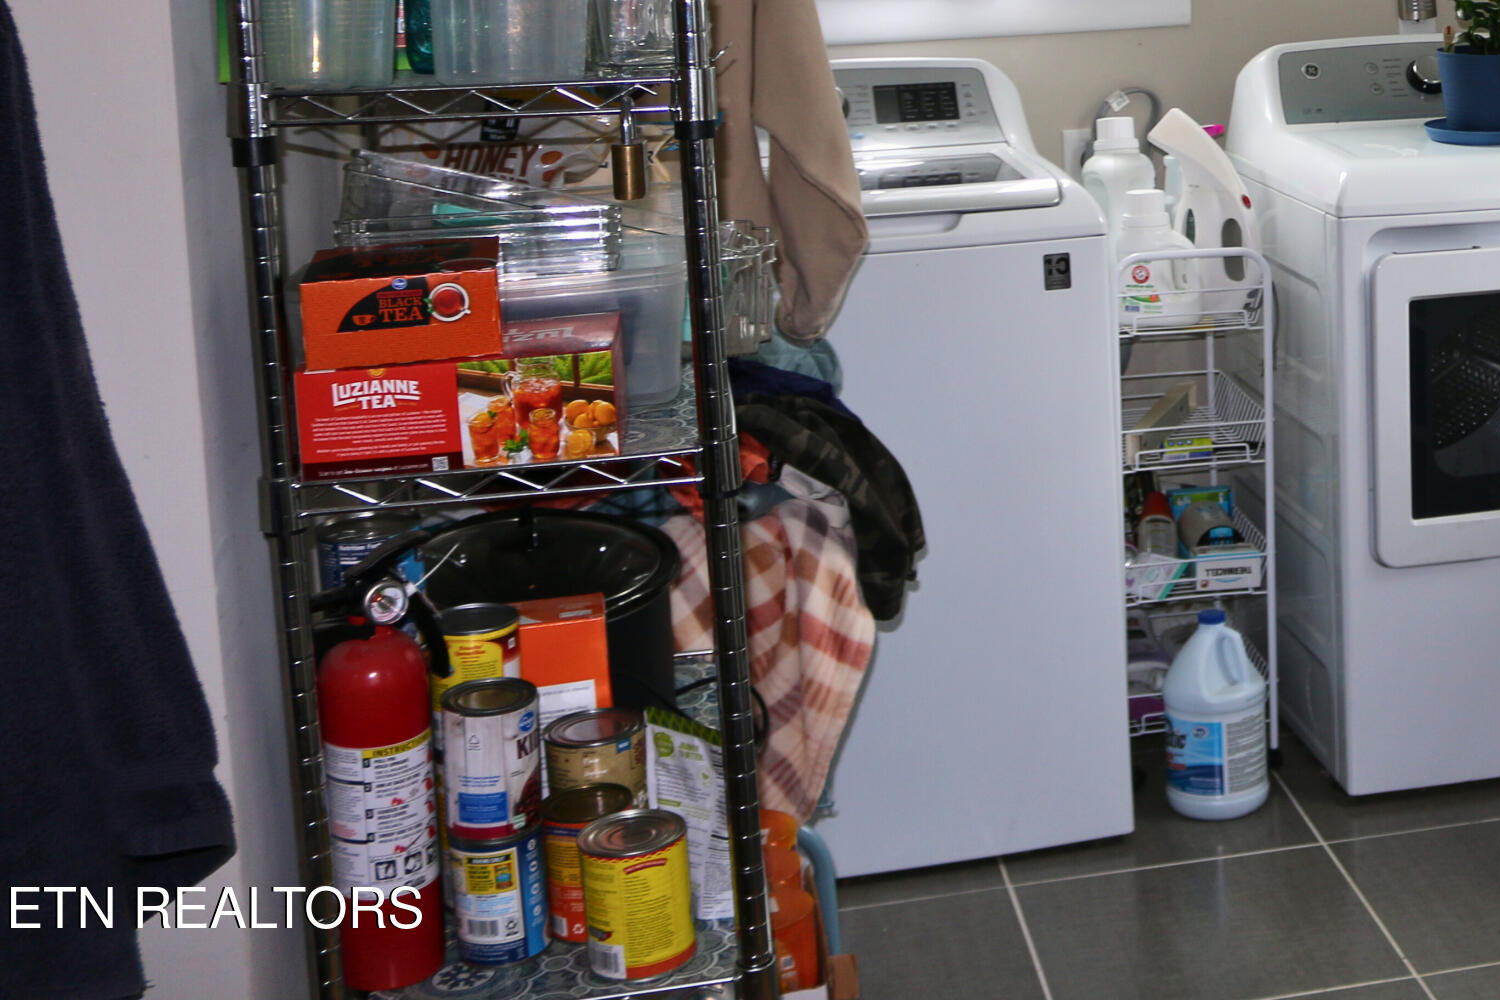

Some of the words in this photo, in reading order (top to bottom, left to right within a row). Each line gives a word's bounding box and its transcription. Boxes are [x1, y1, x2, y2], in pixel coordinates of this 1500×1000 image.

[443, 143, 538, 178] HONEY
[378, 296, 423, 309] BLACK
[378, 307, 425, 323] TEA
[331, 379, 422, 407] LUZIANNE
[357, 394, 396, 410] TEA
